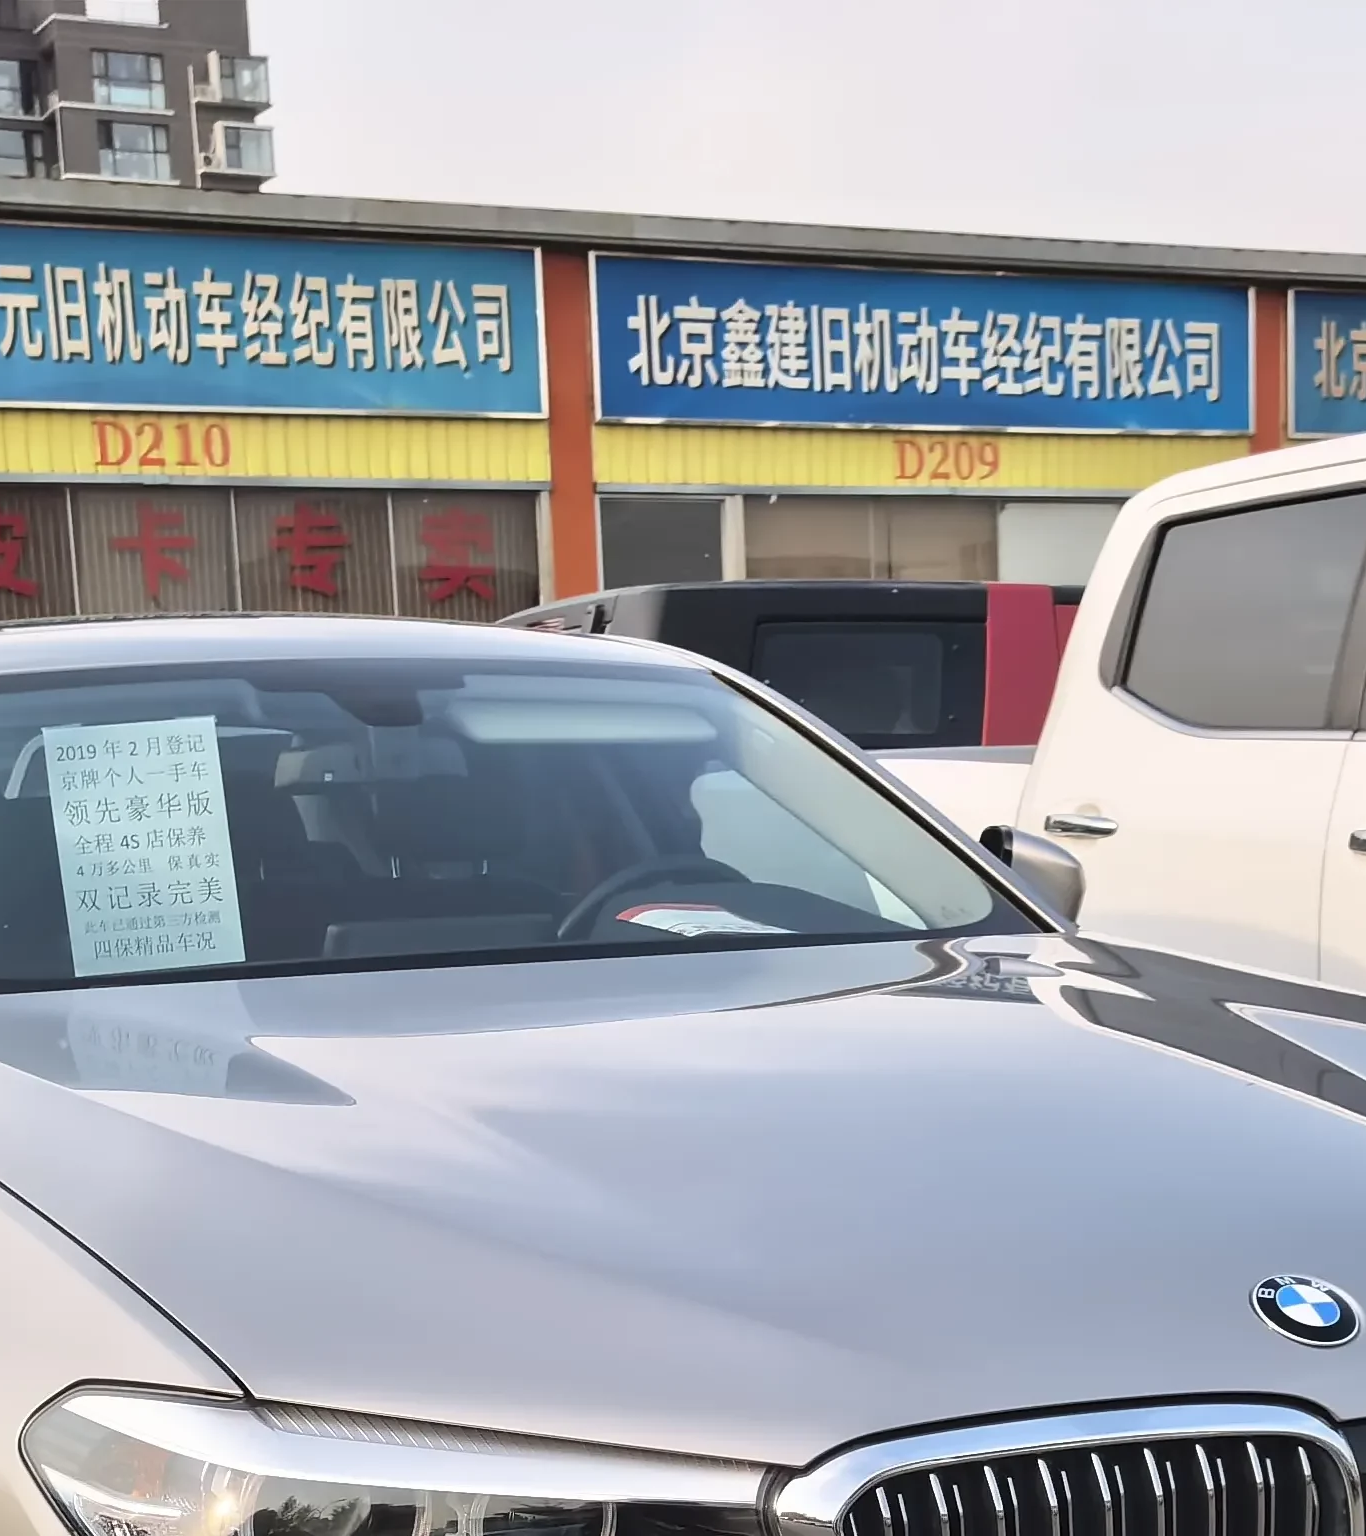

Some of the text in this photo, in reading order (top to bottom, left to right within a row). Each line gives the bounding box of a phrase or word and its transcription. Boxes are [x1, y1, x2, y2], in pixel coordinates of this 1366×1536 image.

[627, 294, 1221, 402] 北京鑫建旧机动车经纪有限公司
[91, 418, 232, 468] D210
[894, 439, 1001, 482] D209
[60, 761, 209, 792] 京牌个人一手车
[63, 790, 214, 827] 领先豪华版
[76, 876, 223, 913] 双记录完美
[94, 931, 216, 960] 四保精品车况
[1257, 1276, 1330, 1299] BMW
